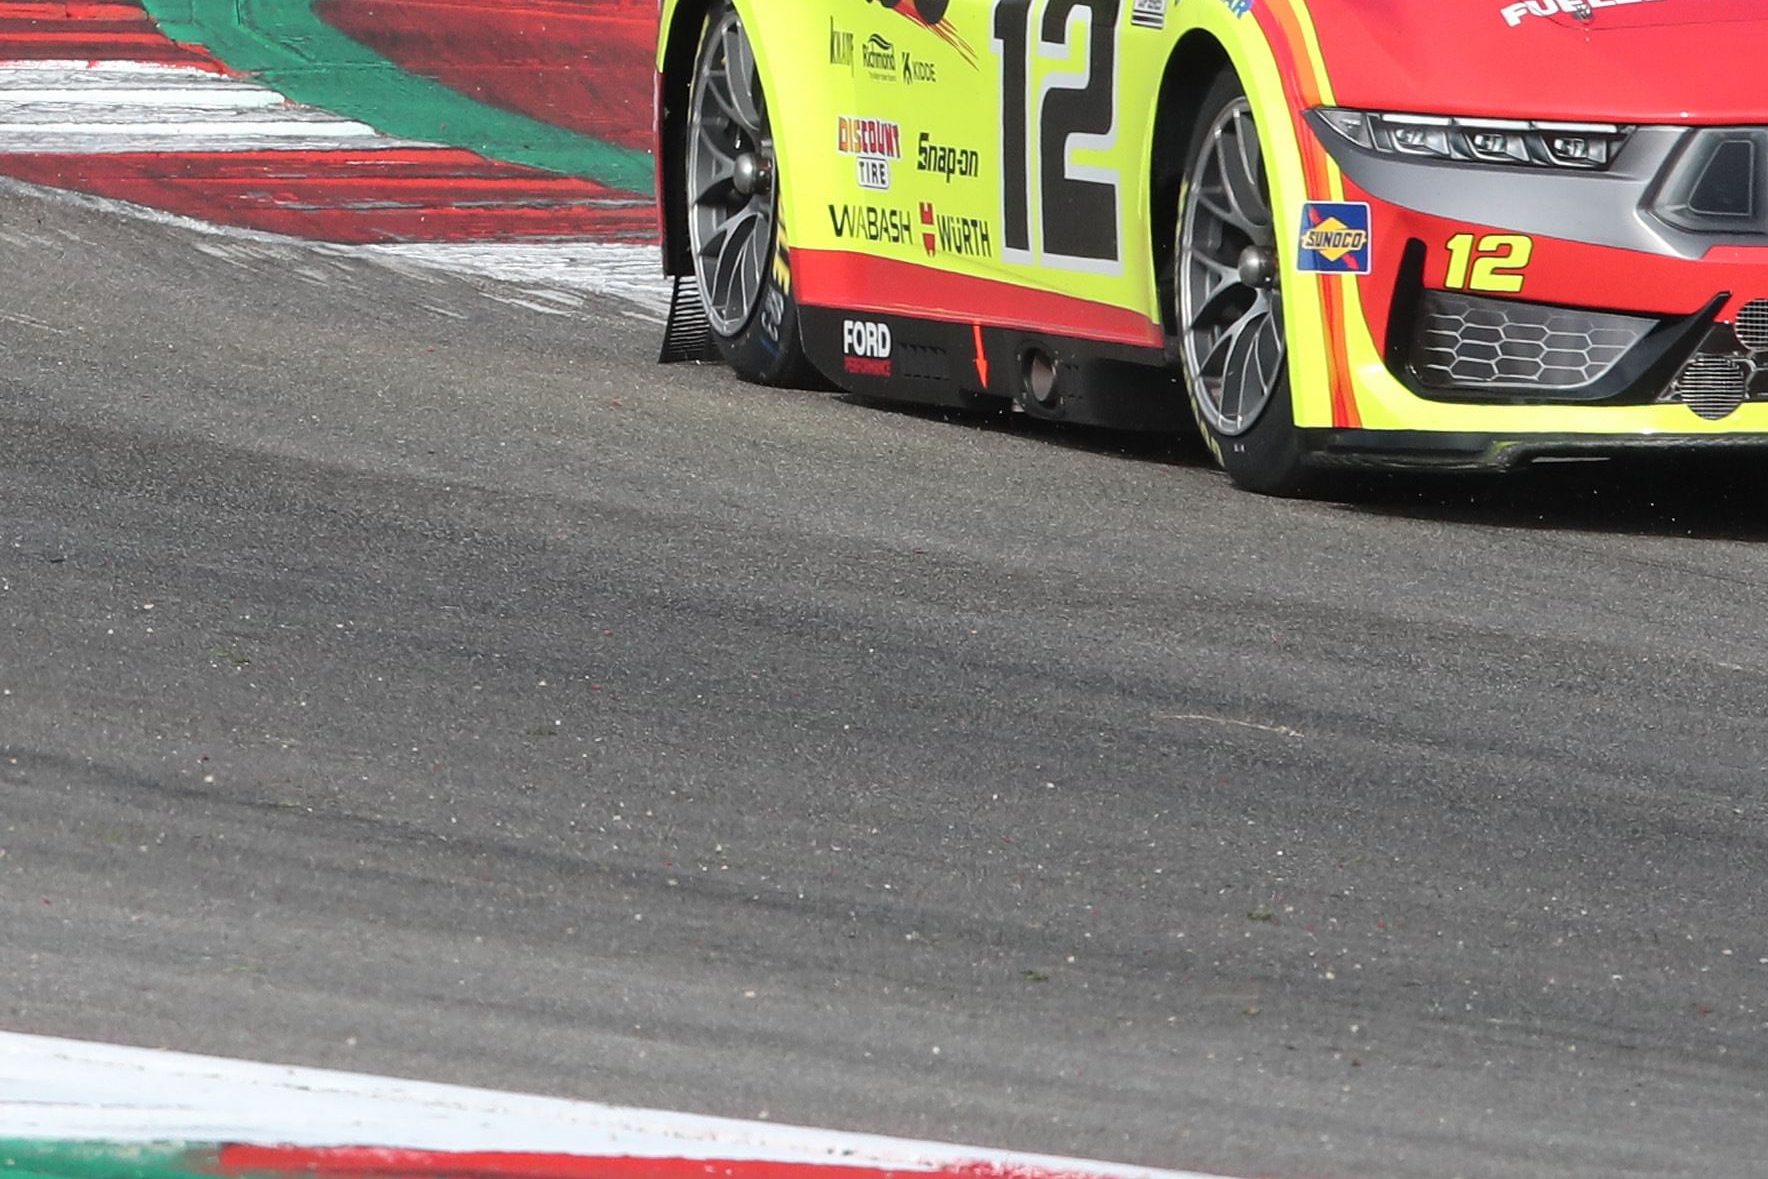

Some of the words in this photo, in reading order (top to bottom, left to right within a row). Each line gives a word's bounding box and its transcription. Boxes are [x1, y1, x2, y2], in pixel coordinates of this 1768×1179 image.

[913, 61, 937, 83] KIDDE
[838, 117, 902, 159] DISCOUNT
[917, 132, 979, 184] Snap-on
[858, 161, 887, 185] TIRE
[828, 204, 914, 246] WABASH
[1306, 231, 1365, 249] SUNOCO
[1445, 233, 1534, 293] 12
[843, 320, 891, 358] FORD
